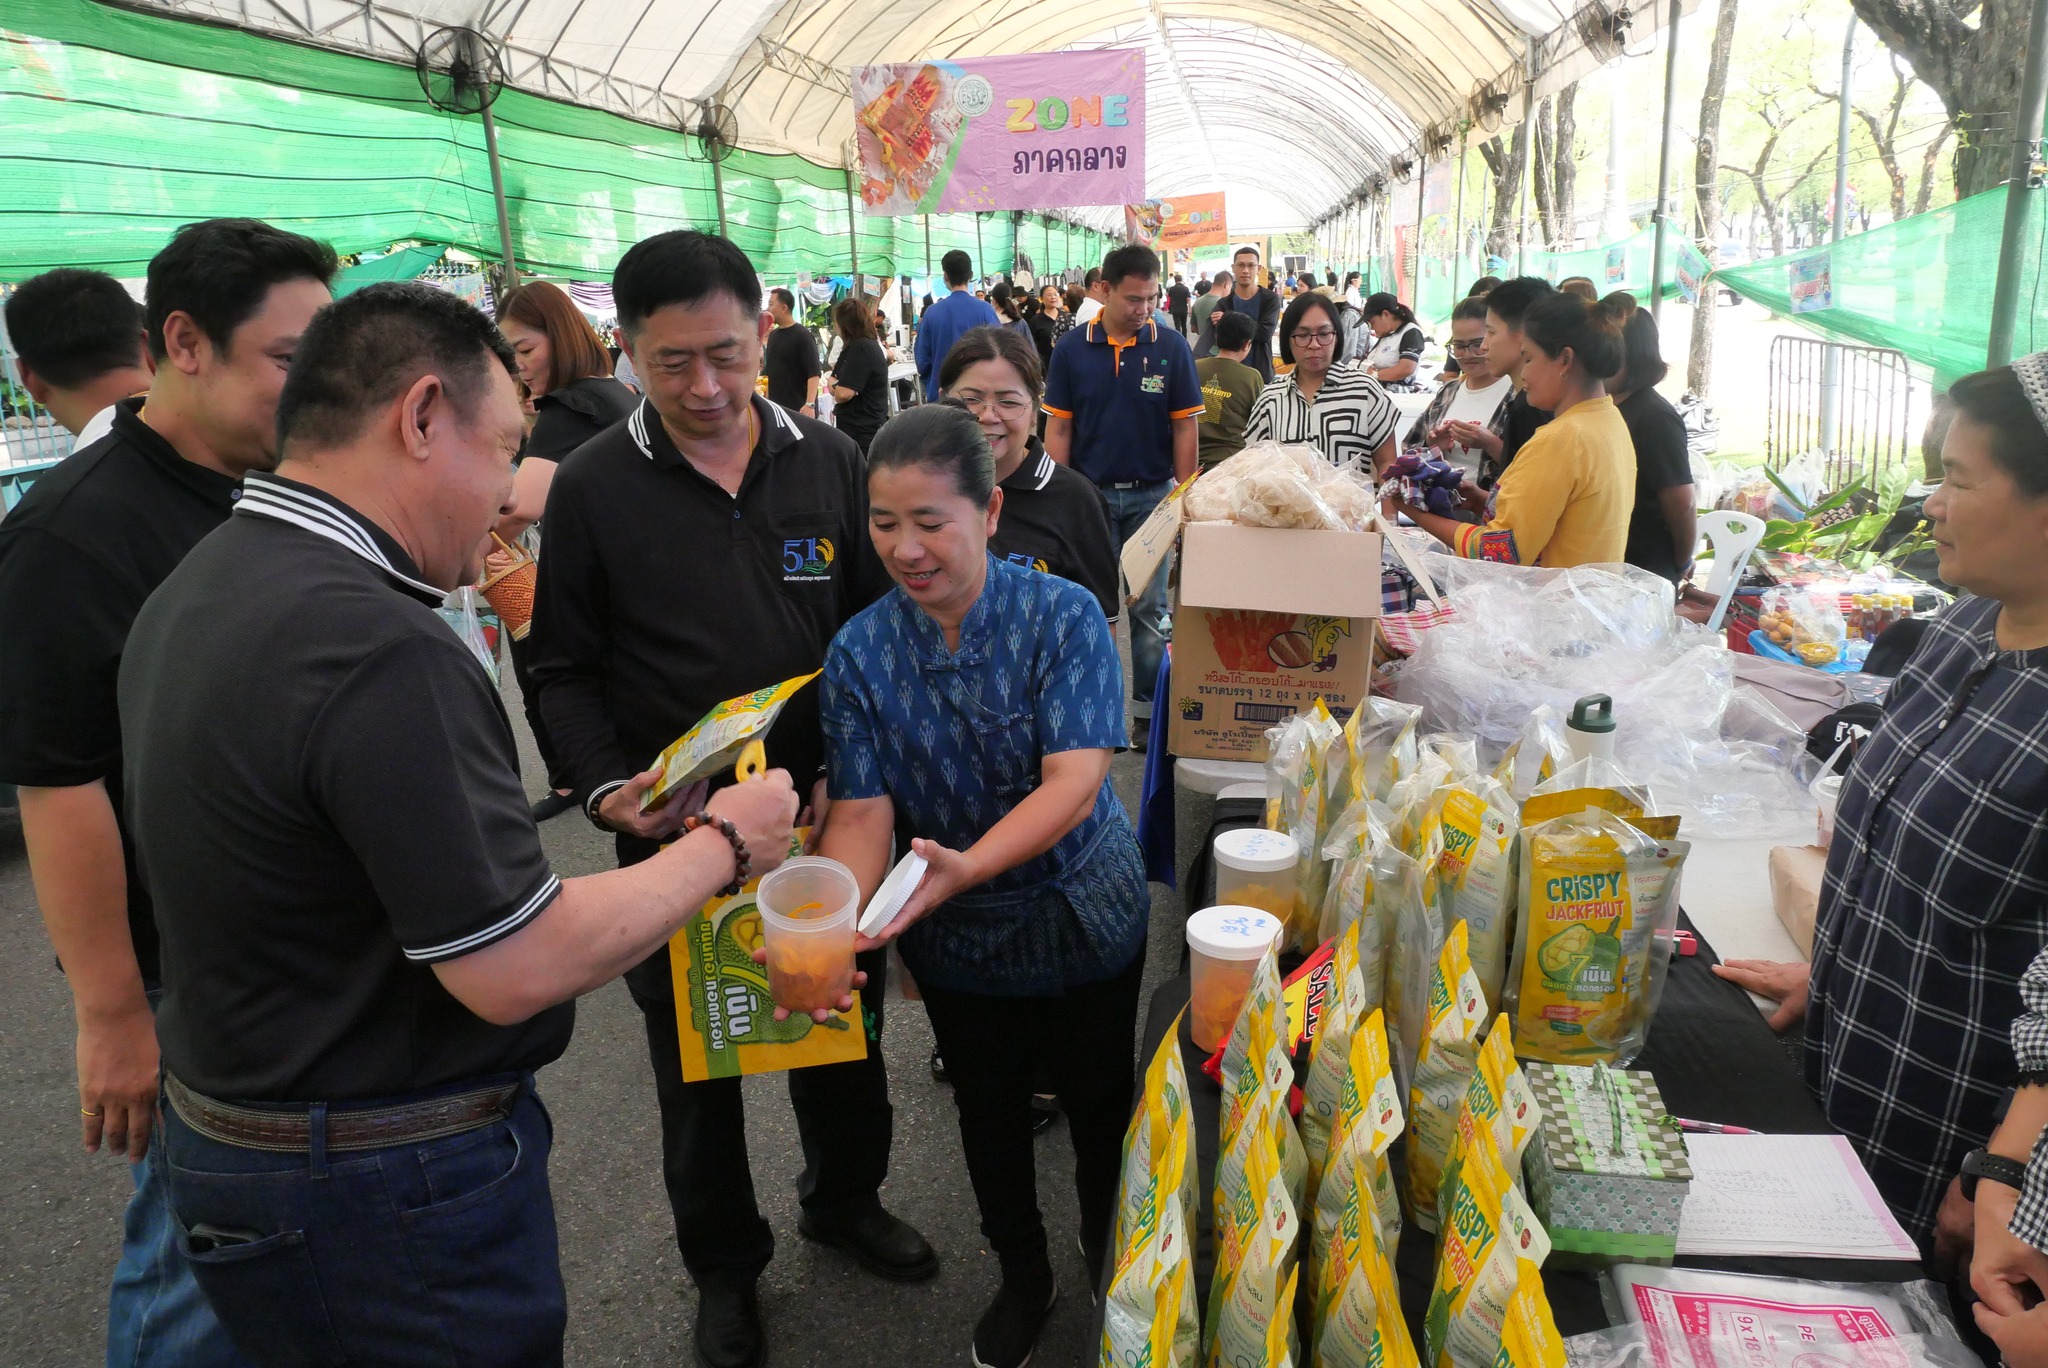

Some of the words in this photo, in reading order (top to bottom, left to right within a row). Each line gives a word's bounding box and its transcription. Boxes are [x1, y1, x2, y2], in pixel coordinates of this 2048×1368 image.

[1006, 94, 1129, 133] ZONE
[1012, 145, 1127, 175] ภาคกลาง
[1178, 209, 1222, 225] ZONE
[782, 537, 819, 573] 51
[1198, 684, 1253, 701] ขนาดบรรจุ
[1259, 688, 1272, 699] 12
[1276, 690, 1289, 702] ถุง
[1324, 693, 1346, 703] ซอง
[1570, 953, 1591, 982] 7
[1582, 964, 1612, 983] เนิน
[694, 920, 726, 1050] ขนุนทองทอดกรอบ
[724, 985, 758, 1037] เนิน
[1737, 1316, 1754, 1326] 9
[1797, 1324, 1817, 1343] PE
[1743, 1336, 1762, 1350] 18
